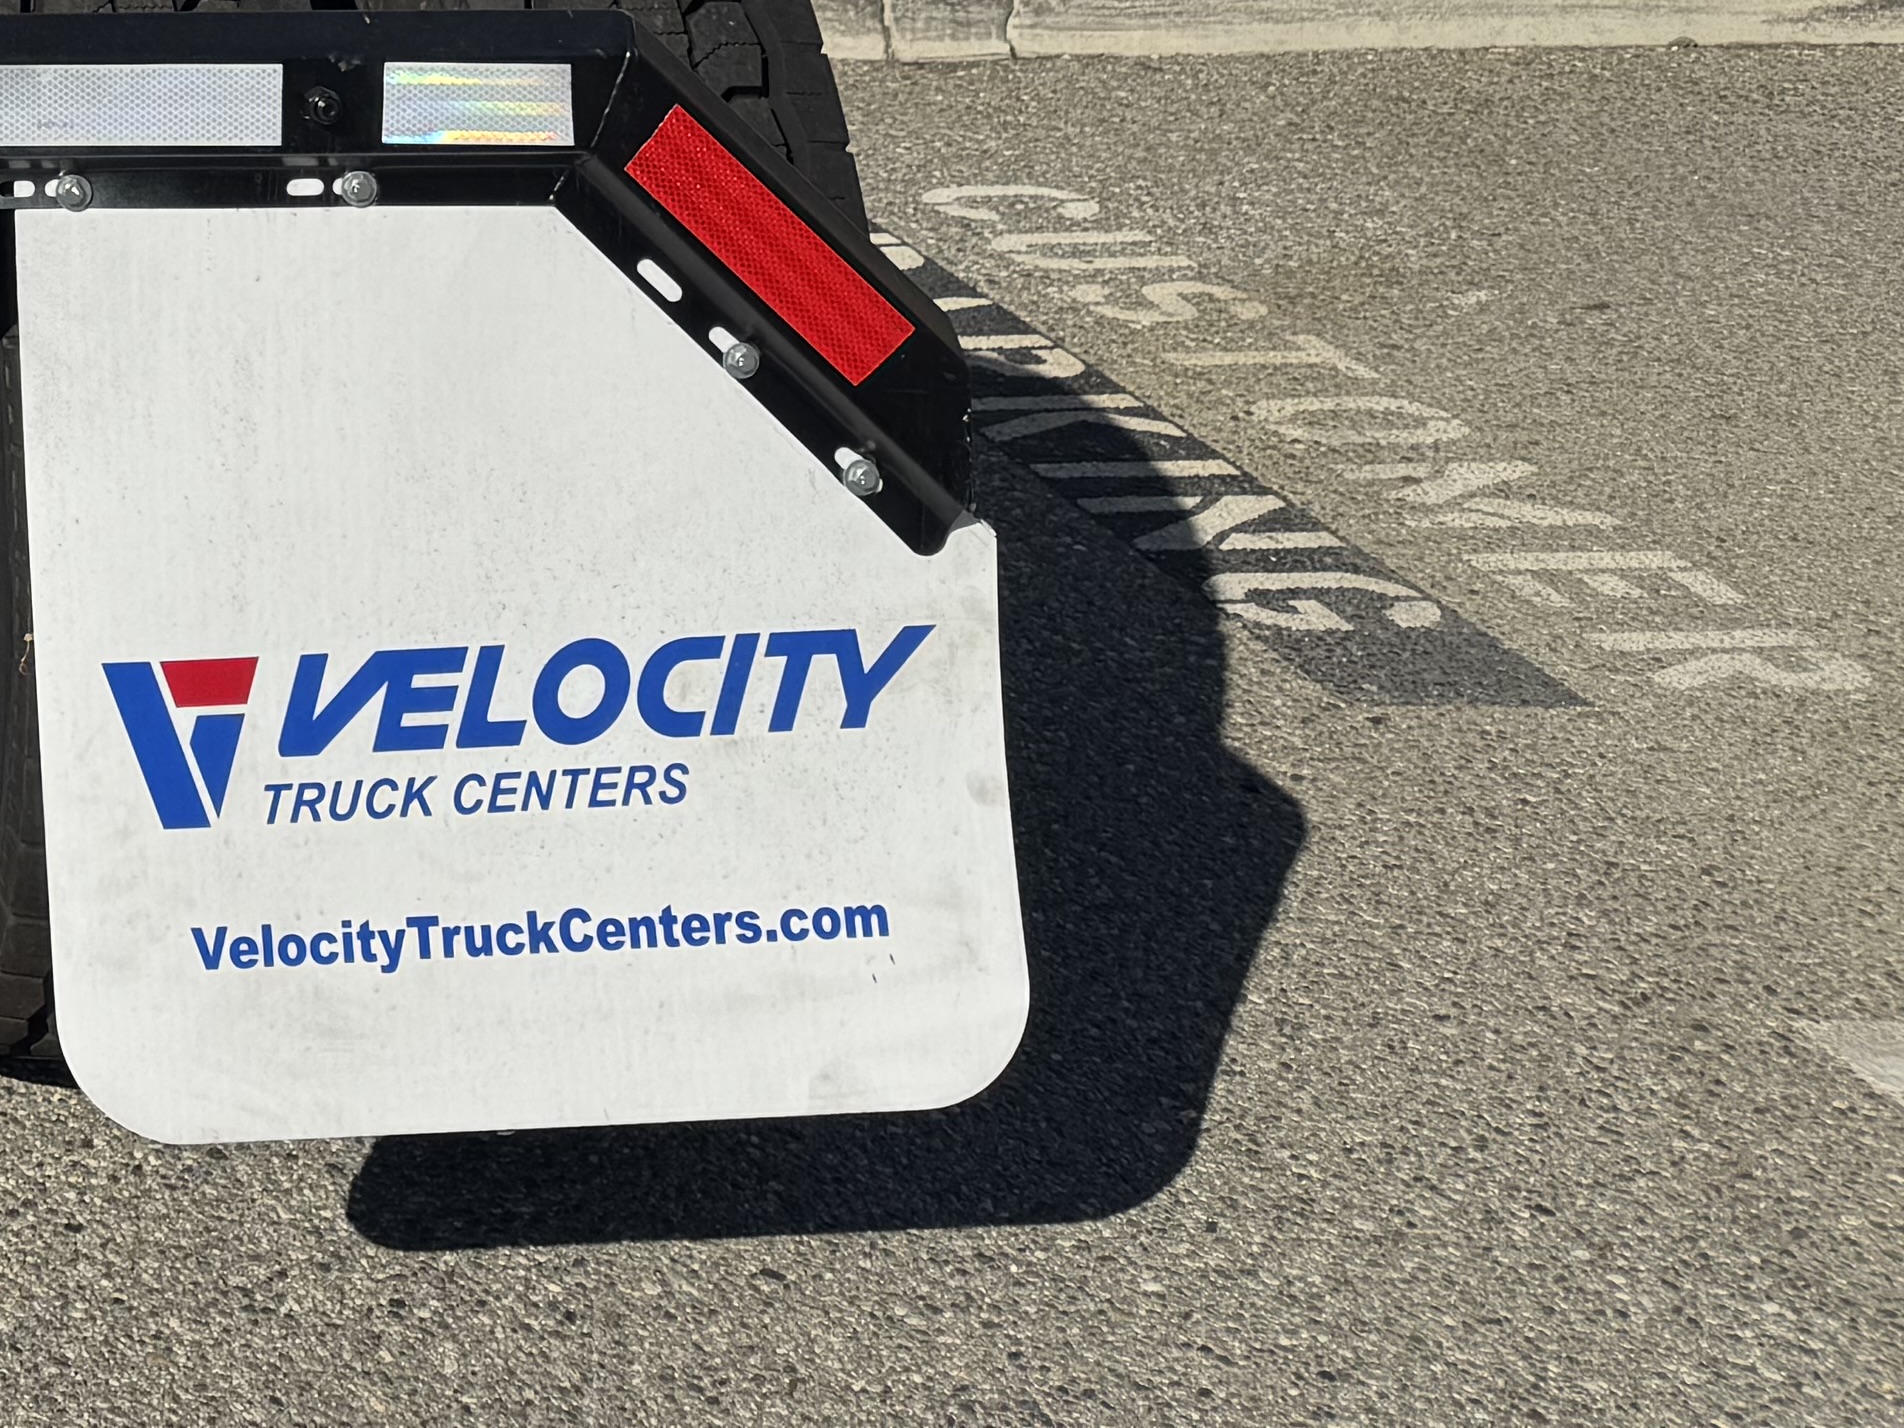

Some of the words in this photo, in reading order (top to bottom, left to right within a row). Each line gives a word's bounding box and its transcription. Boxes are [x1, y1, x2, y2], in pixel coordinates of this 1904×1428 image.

[921, 183, 1874, 692] CUSTOMER
[279, 625, 936, 757] VELOCITY
[265, 777, 434, 825] TRUCK
[454, 763, 690, 815] CENTERS
[191, 902, 890, 974] VelocityTruckCenters.com
